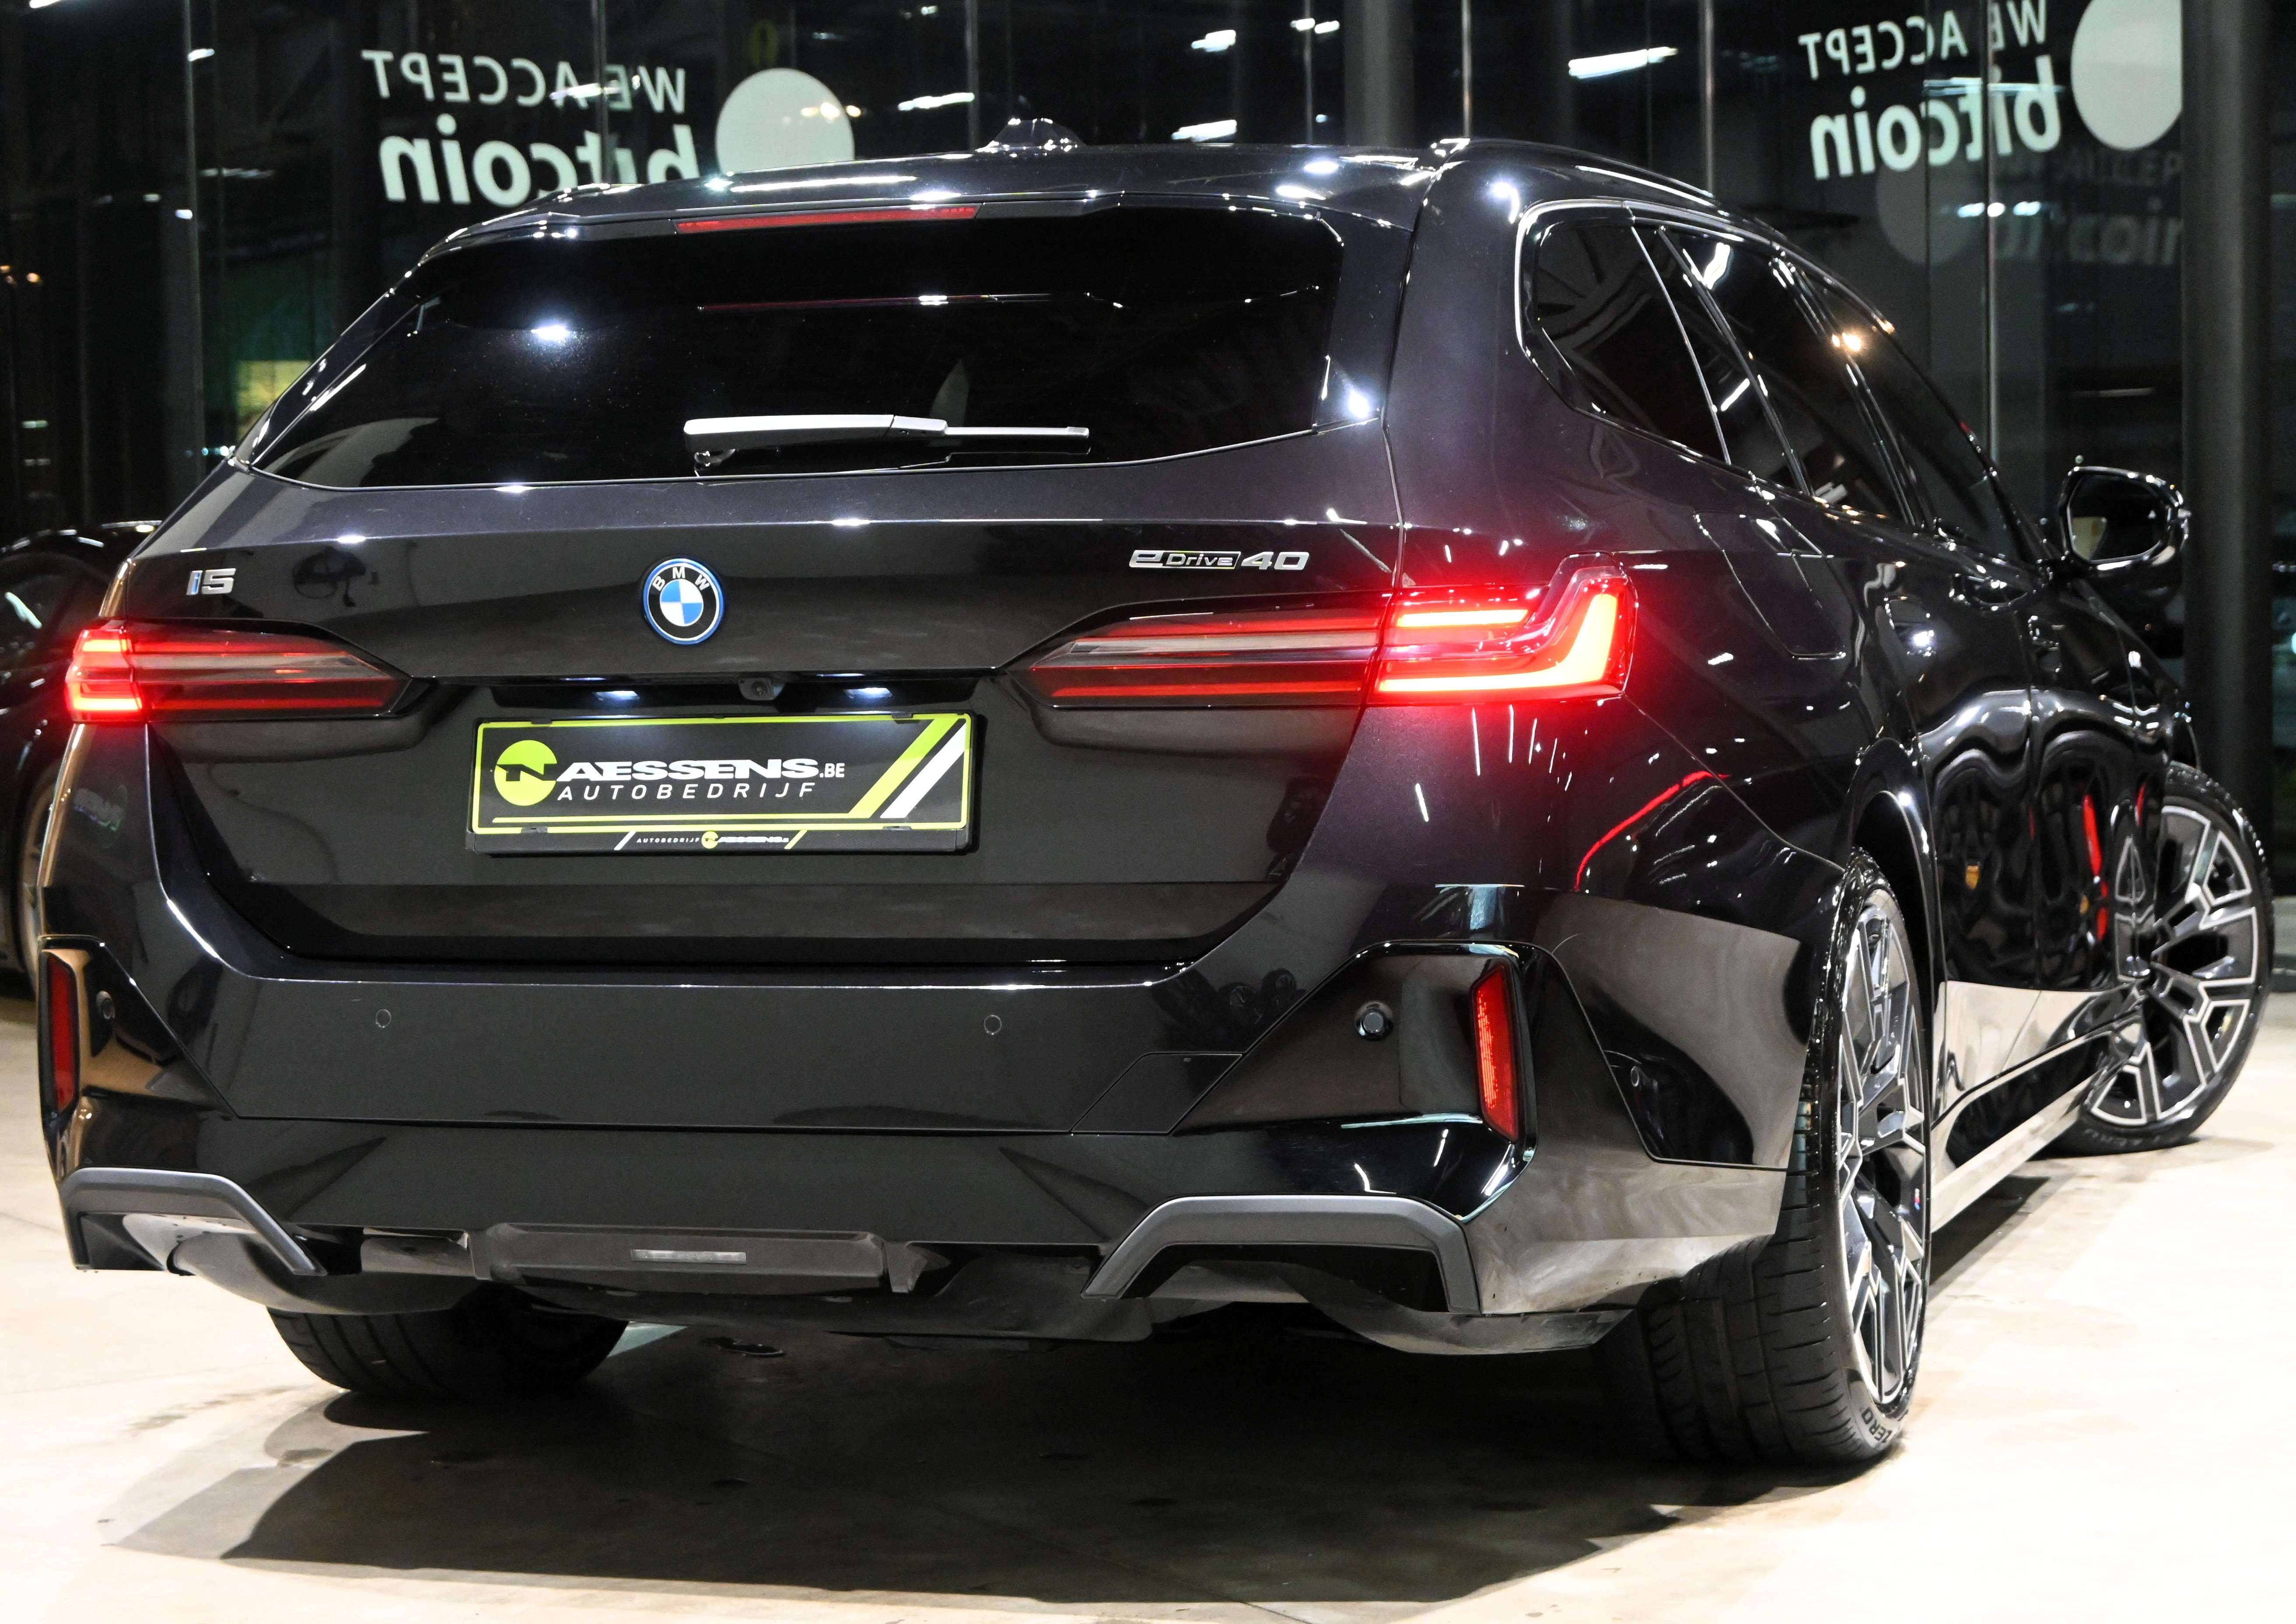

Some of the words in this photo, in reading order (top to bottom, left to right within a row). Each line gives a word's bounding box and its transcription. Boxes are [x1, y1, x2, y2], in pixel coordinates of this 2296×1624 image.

[186, 568, 236, 595] i5
[652, 566, 710, 592] BMW
[557, 782, 815, 800] AUTOBEDRIJF
[1861, 1407, 1893, 1443] ZERO
